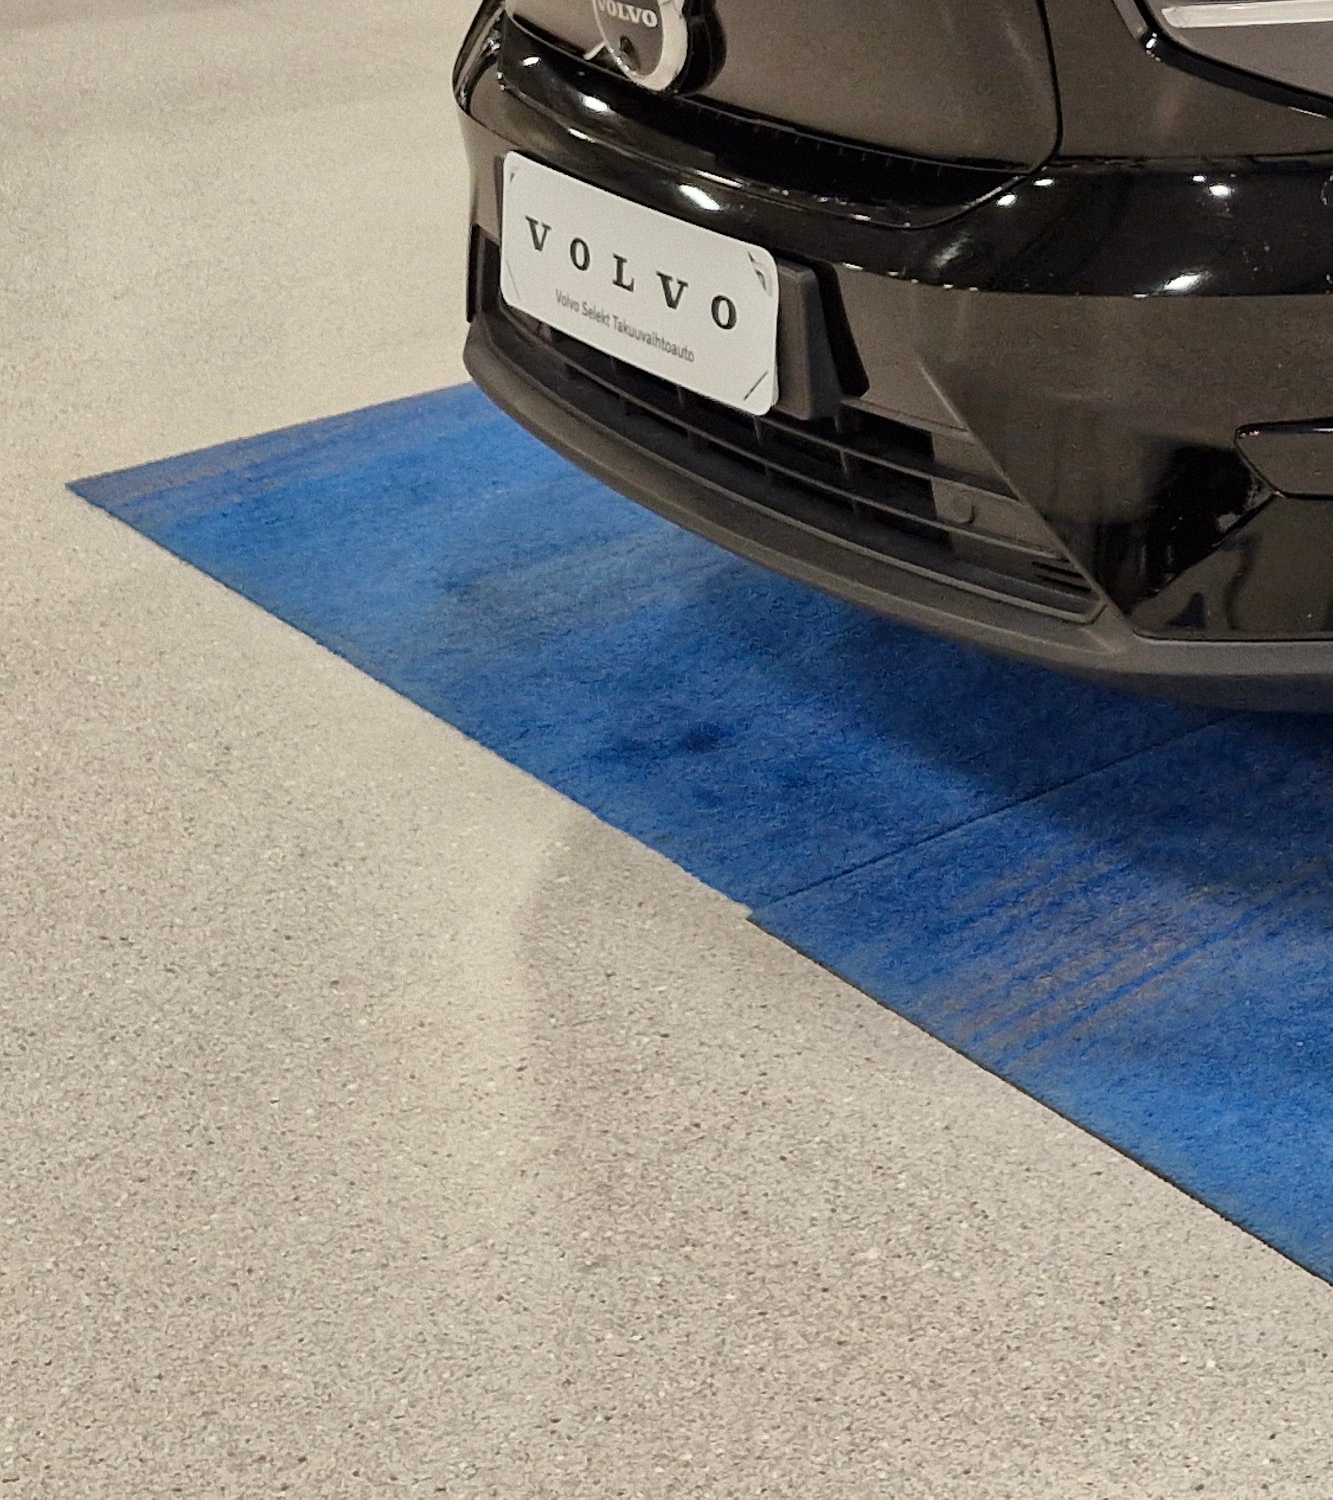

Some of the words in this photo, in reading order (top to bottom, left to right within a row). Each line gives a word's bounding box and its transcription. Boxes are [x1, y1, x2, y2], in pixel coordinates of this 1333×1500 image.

[525, 215, 737, 330] VOLVO
[555, 288, 580, 313] Volvo
[582, 301, 611, 327] Selekt
[612, 314, 695, 362] Takuuvaihtoauto
